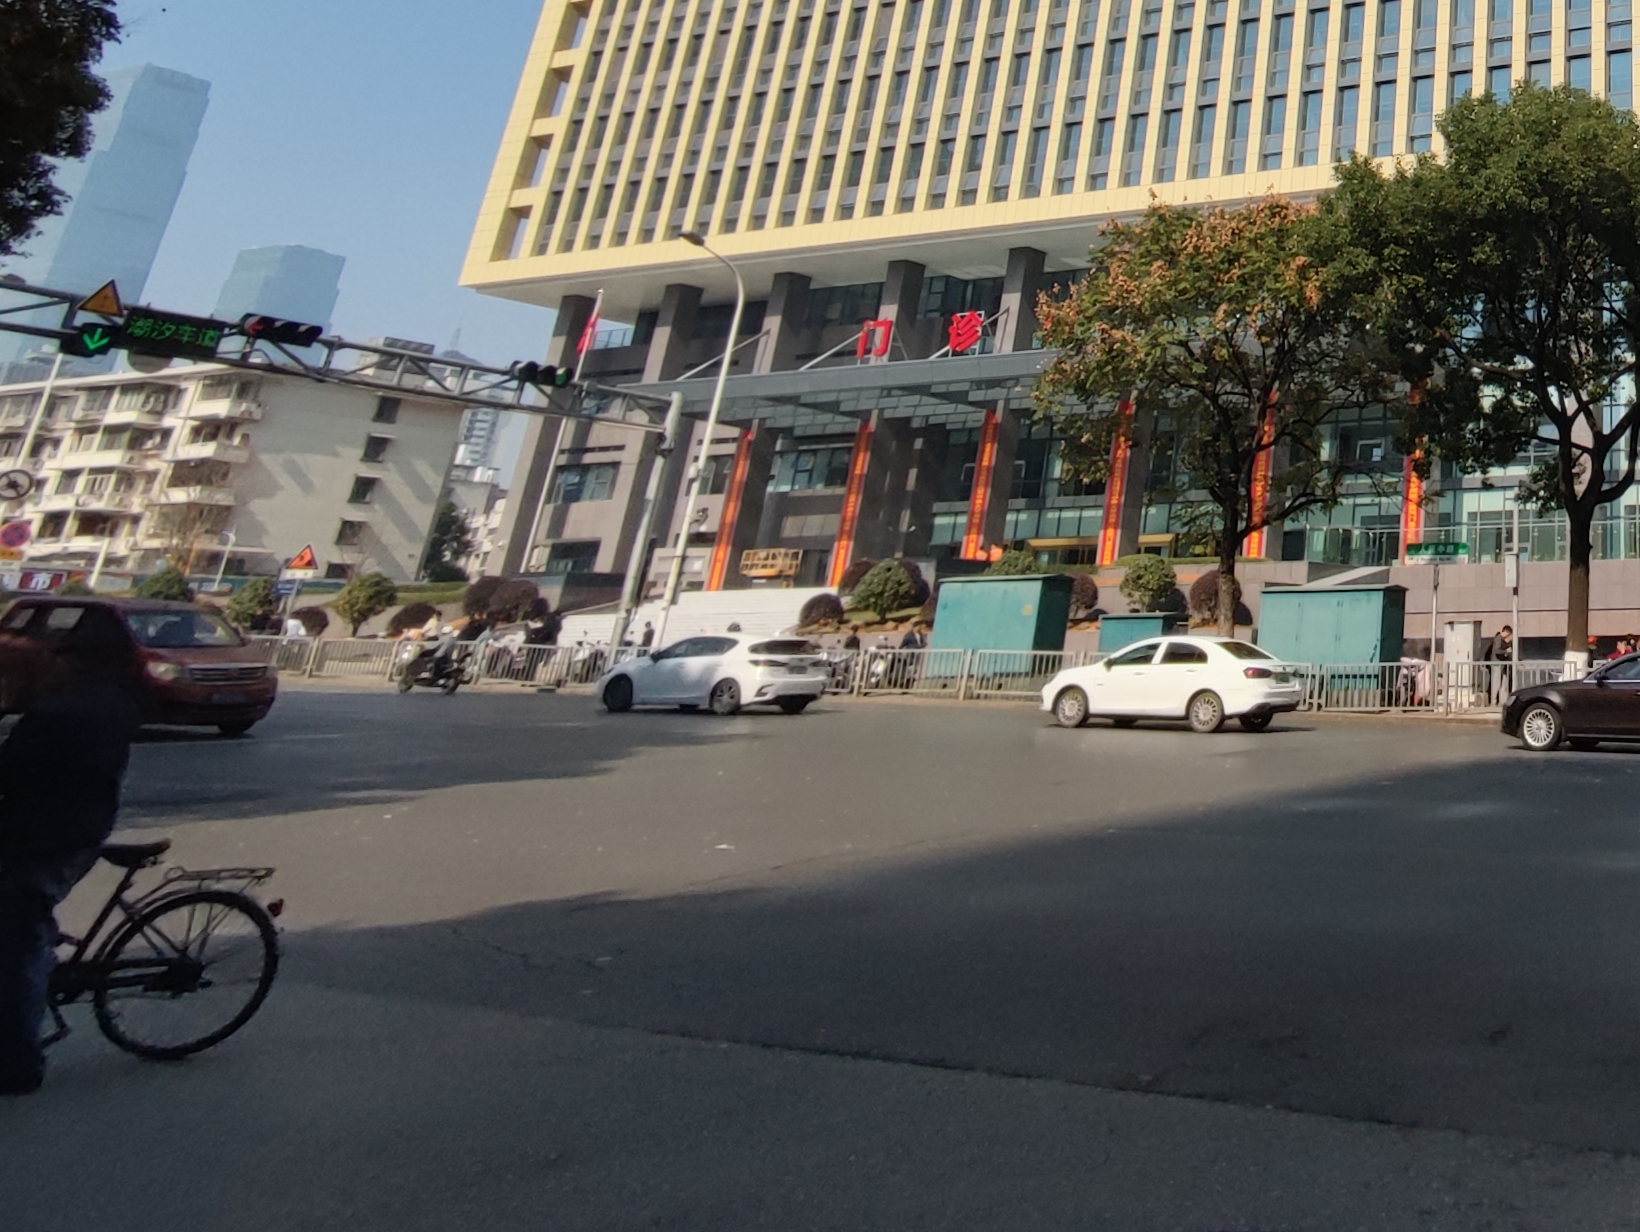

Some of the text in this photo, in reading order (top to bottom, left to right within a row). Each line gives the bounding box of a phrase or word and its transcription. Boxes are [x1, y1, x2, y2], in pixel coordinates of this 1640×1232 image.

[127, 316, 219, 347] 潮汐车道
[857, 310, 984, 359] 门诊
